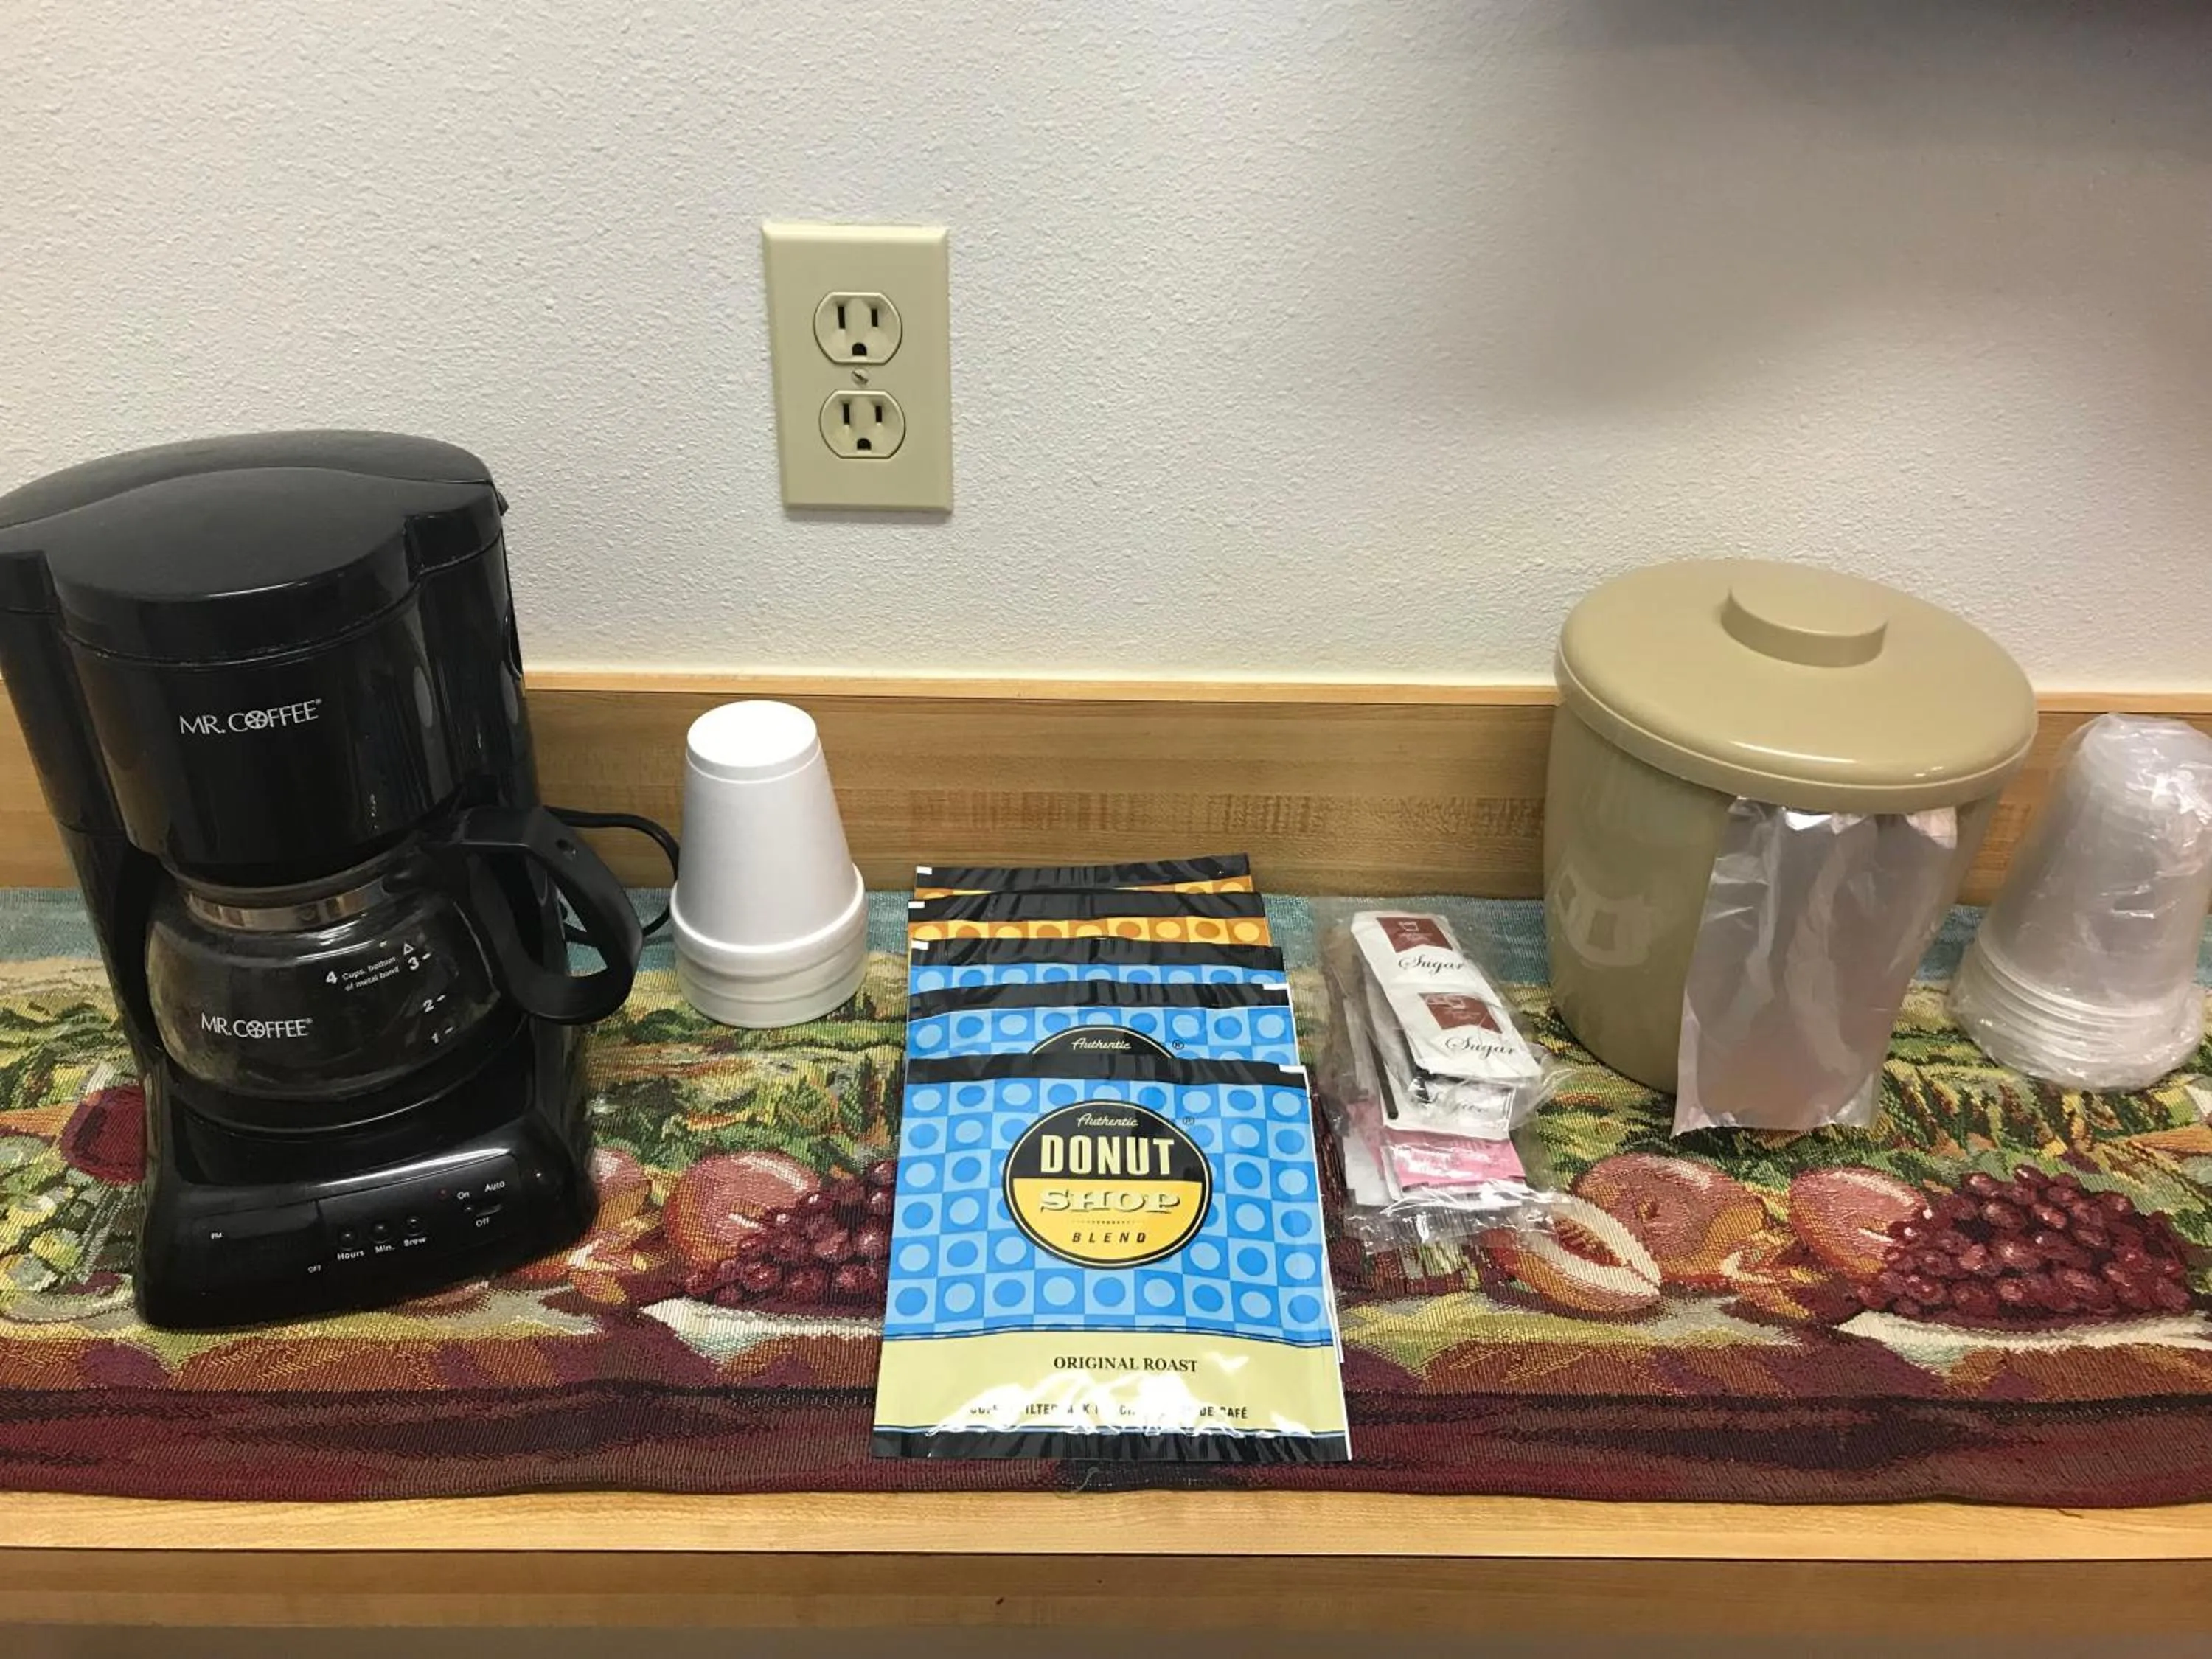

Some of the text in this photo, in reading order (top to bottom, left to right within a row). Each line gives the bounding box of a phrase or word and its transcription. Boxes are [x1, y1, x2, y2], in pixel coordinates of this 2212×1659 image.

[180, 700, 319, 734] MR. COFFEE
[326, 971, 338, 984] 4
[368, 956, 397, 972] bottom
[408, 956, 420, 970] 3
[1398, 954, 1463, 976] Sugar
[355, 975, 378, 988] metal
[380, 966, 400, 979] band
[422, 999, 434, 1013] 2
[201, 1012, 308, 1038] MR. COFFEE
[431, 1033, 439, 1044] 1
[1071, 1037, 1131, 1050] Authentic
[1445, 1036, 1515, 1060] Sugar
[1077, 1113, 1138, 1127] Authentic
[1040, 1135, 1174, 1175] DONUT
[485, 1180, 505, 1192] Auto
[457, 1191, 470, 1200] On
[1040, 1189, 1180, 1214] SHOP
[476, 1217, 490, 1227] Off
[404, 1236, 427, 1246] Brew
[1072, 1232, 1146, 1243] BLEND
[337, 1250, 364, 1261] Hours
[375, 1244, 395, 1253] Min.
[1054, 1357, 1197, 1372] ORIGINAL ROAST
